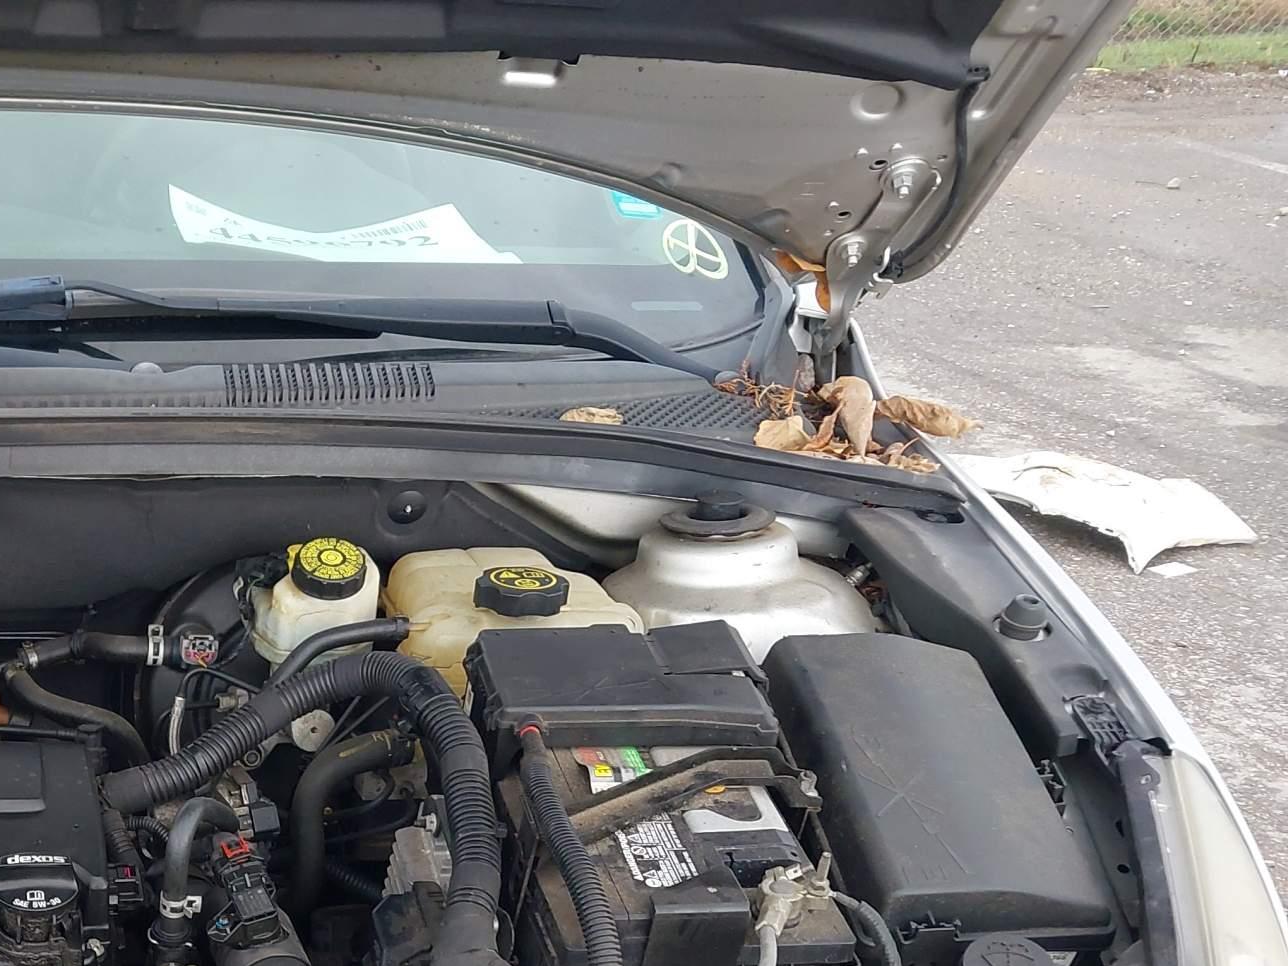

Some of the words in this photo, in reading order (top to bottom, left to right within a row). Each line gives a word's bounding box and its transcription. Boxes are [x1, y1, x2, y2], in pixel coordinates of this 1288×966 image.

[6, 854, 65, 865] dexos
[12, 898, 30, 908] SAE
[32, 897, 62, 908] 5W-30
